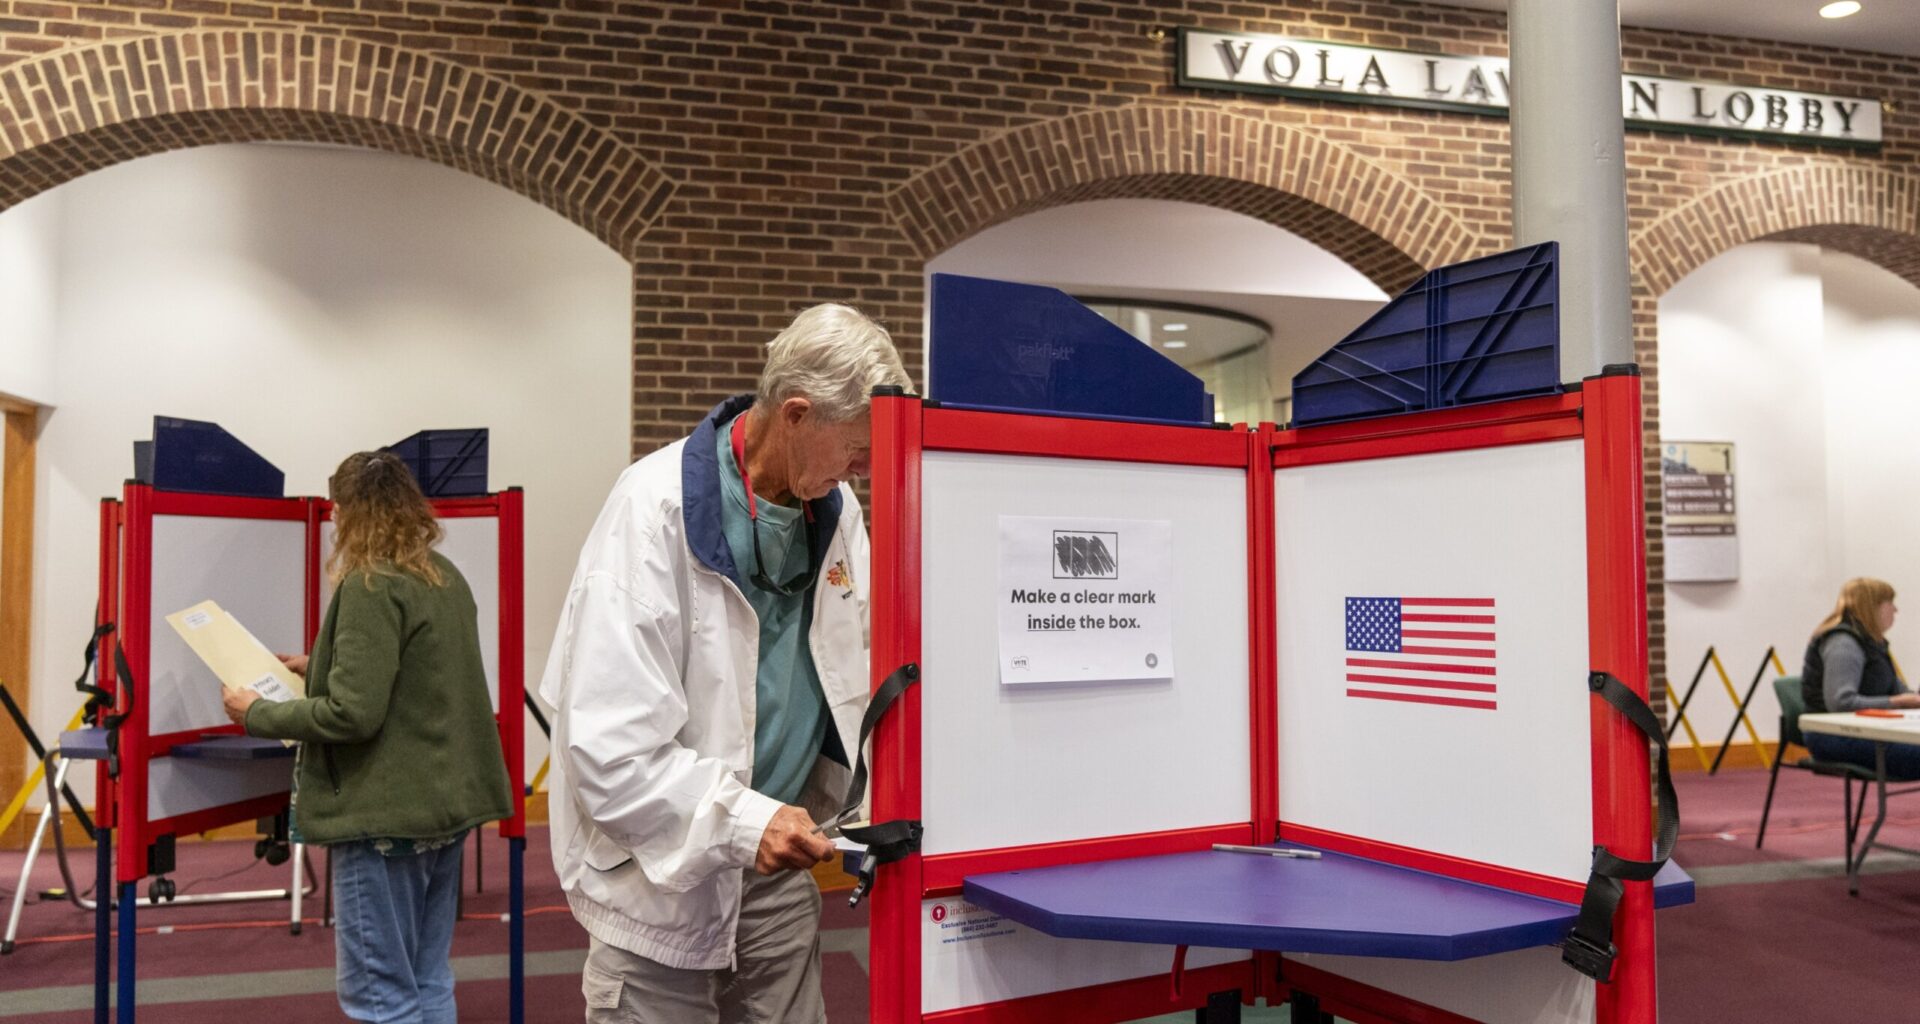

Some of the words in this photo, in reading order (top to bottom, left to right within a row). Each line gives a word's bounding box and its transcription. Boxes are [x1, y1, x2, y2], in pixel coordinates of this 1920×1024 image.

[1215, 39, 1391, 90] VOLA
[1690, 86, 1860, 132] LOBBY
[1011, 589, 1057, 604] Make
[1060, 592, 1071, 604] a
[1074, 589, 1115, 604] clear
[1118, 590, 1156, 604] mark
[1027, 614, 1076, 630] inside
[1079, 615, 1105, 629] the
[1109, 615, 1141, 629] box.
